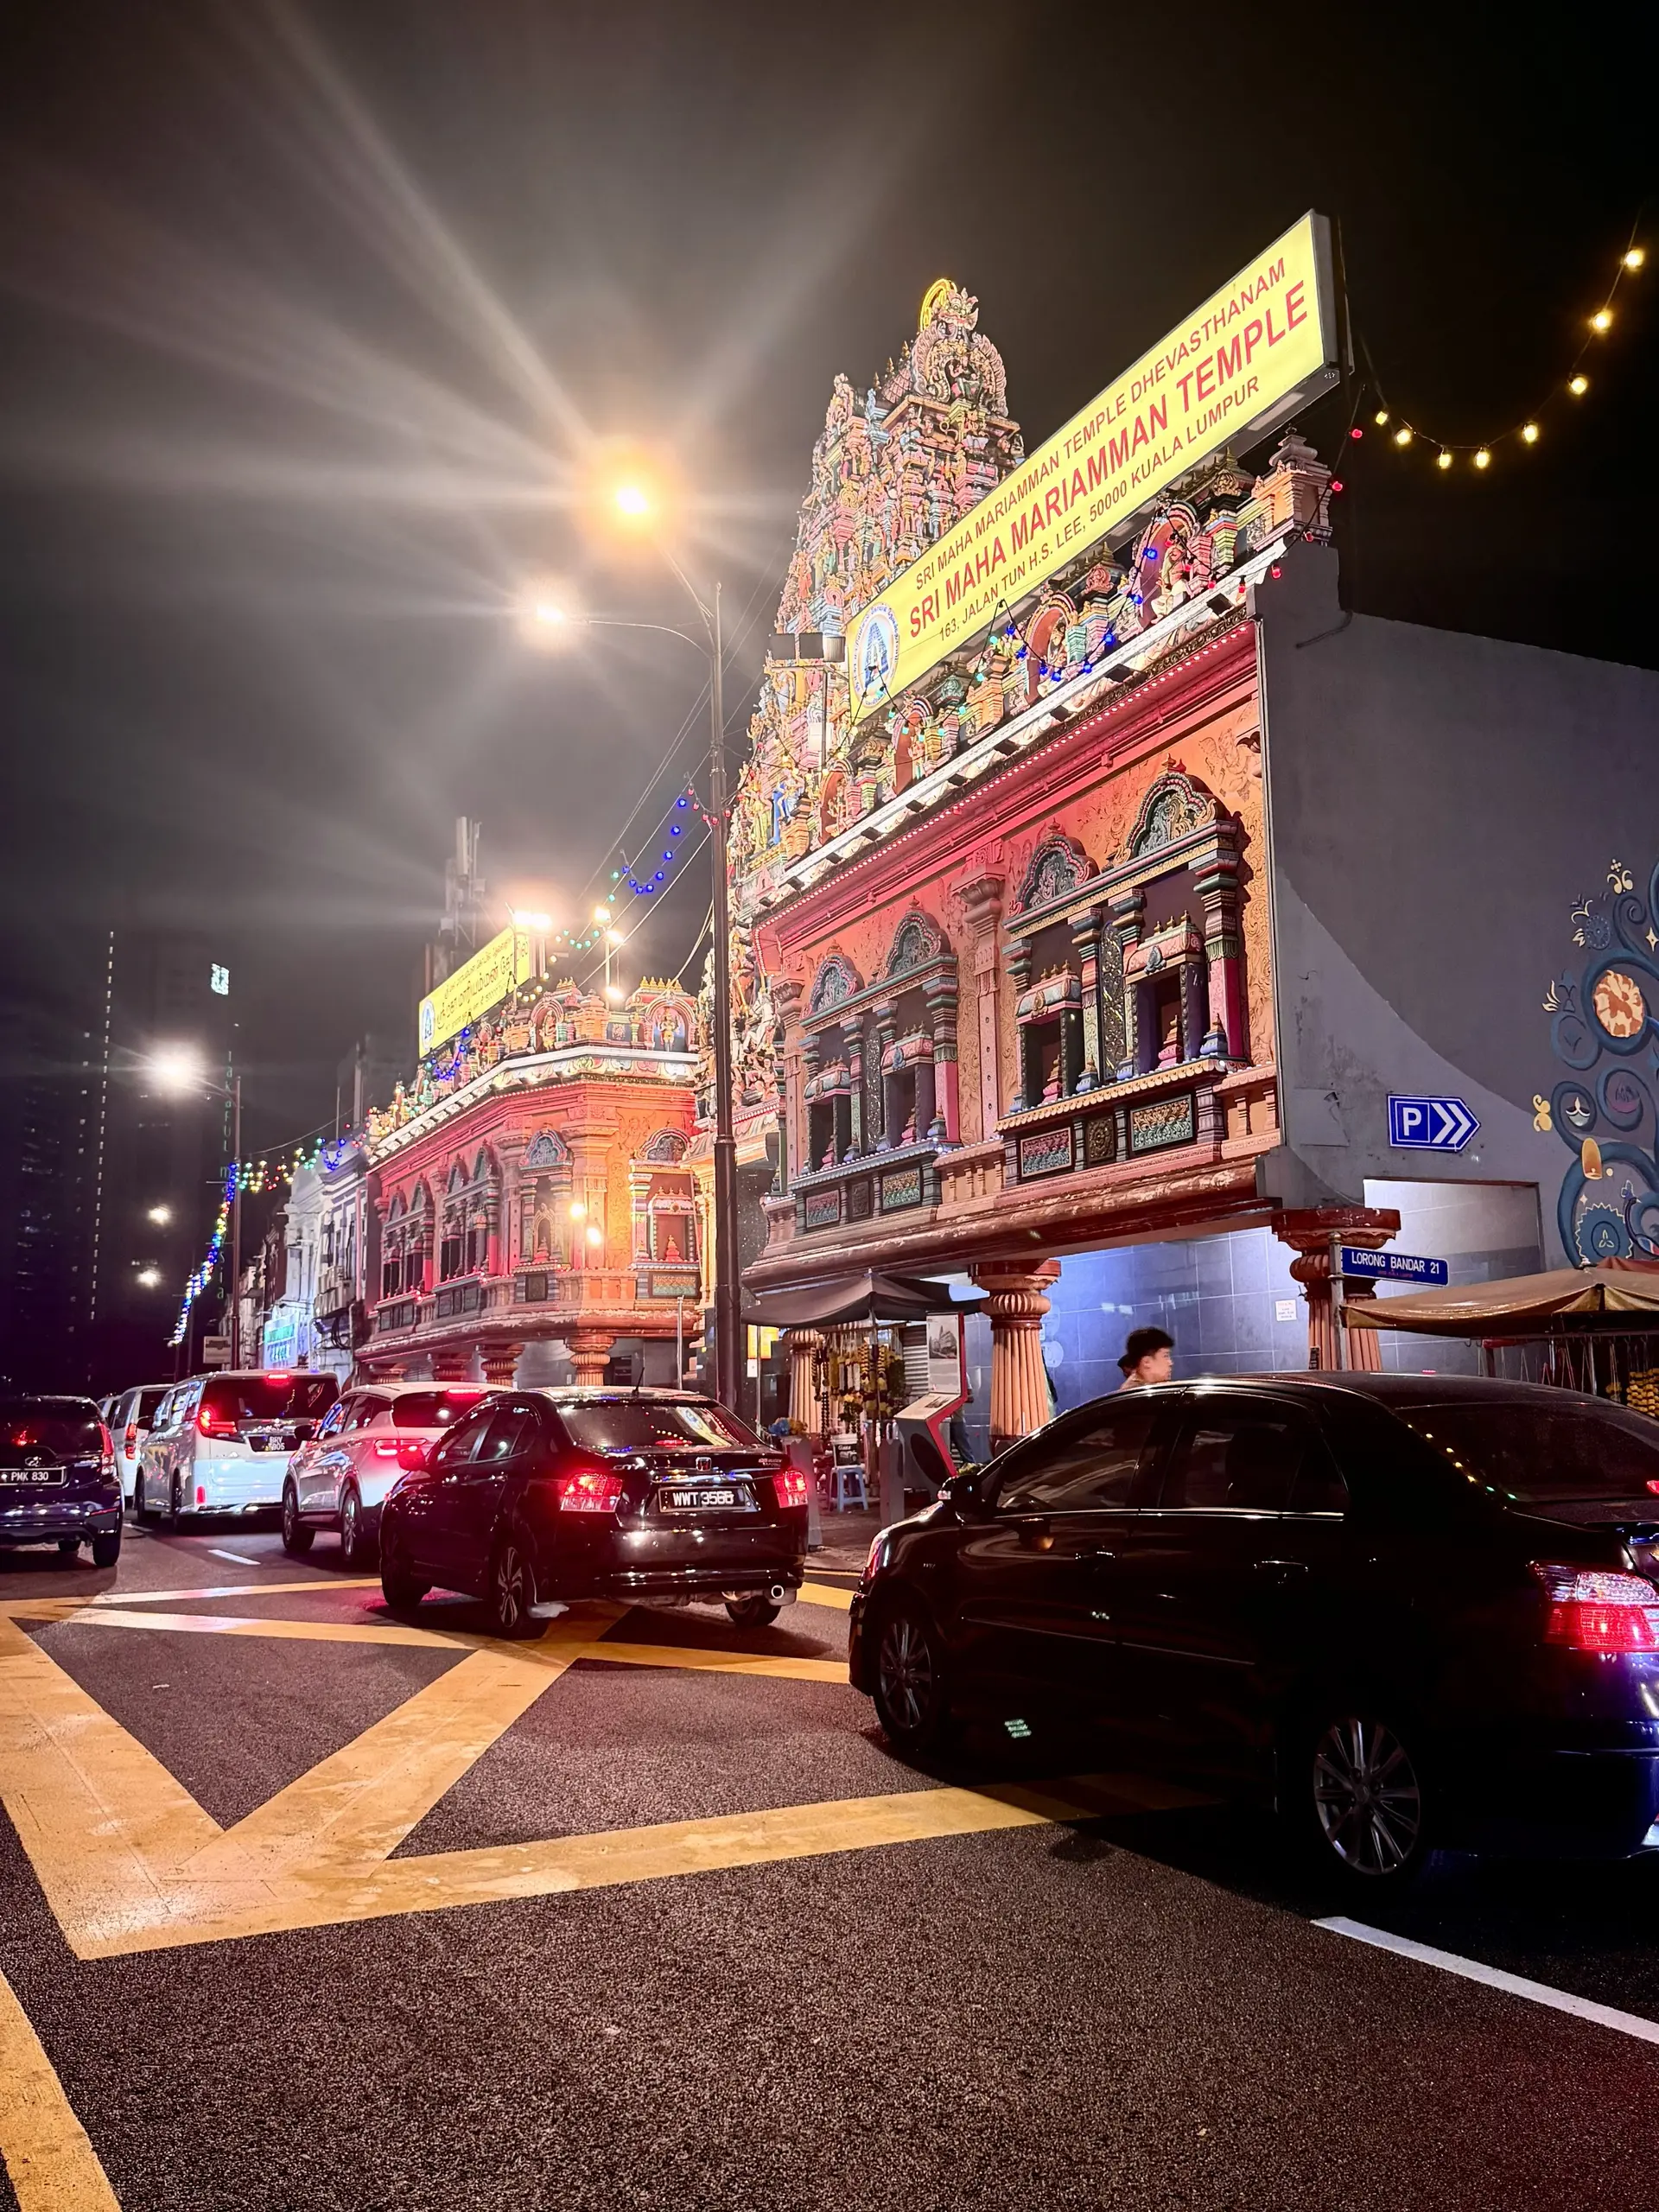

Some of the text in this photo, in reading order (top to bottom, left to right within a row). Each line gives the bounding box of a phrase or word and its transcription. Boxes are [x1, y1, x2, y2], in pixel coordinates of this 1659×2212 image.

[916, 257, 1286, 590] SRI MAHA MARIAMMAN TEMPLE DHEVASTHANAM
[910, 279, 1308, 638] SRI MAHA MARIAMMAN TEMPLE
[938, 376, 1261, 642] 163, JALAN TUN H.S. LEE, 50000 KUALA LUMPUR
[1403, 1107, 1422, 1136] P
[1351, 1250, 1386, 1268] LORONG
[1390, 1256, 1426, 1273] BANDAR
[1430, 1261, 1440, 1274] 21
[10, 1471, 49, 1482] PMK 830
[672, 1491, 699, 1507] WWT
